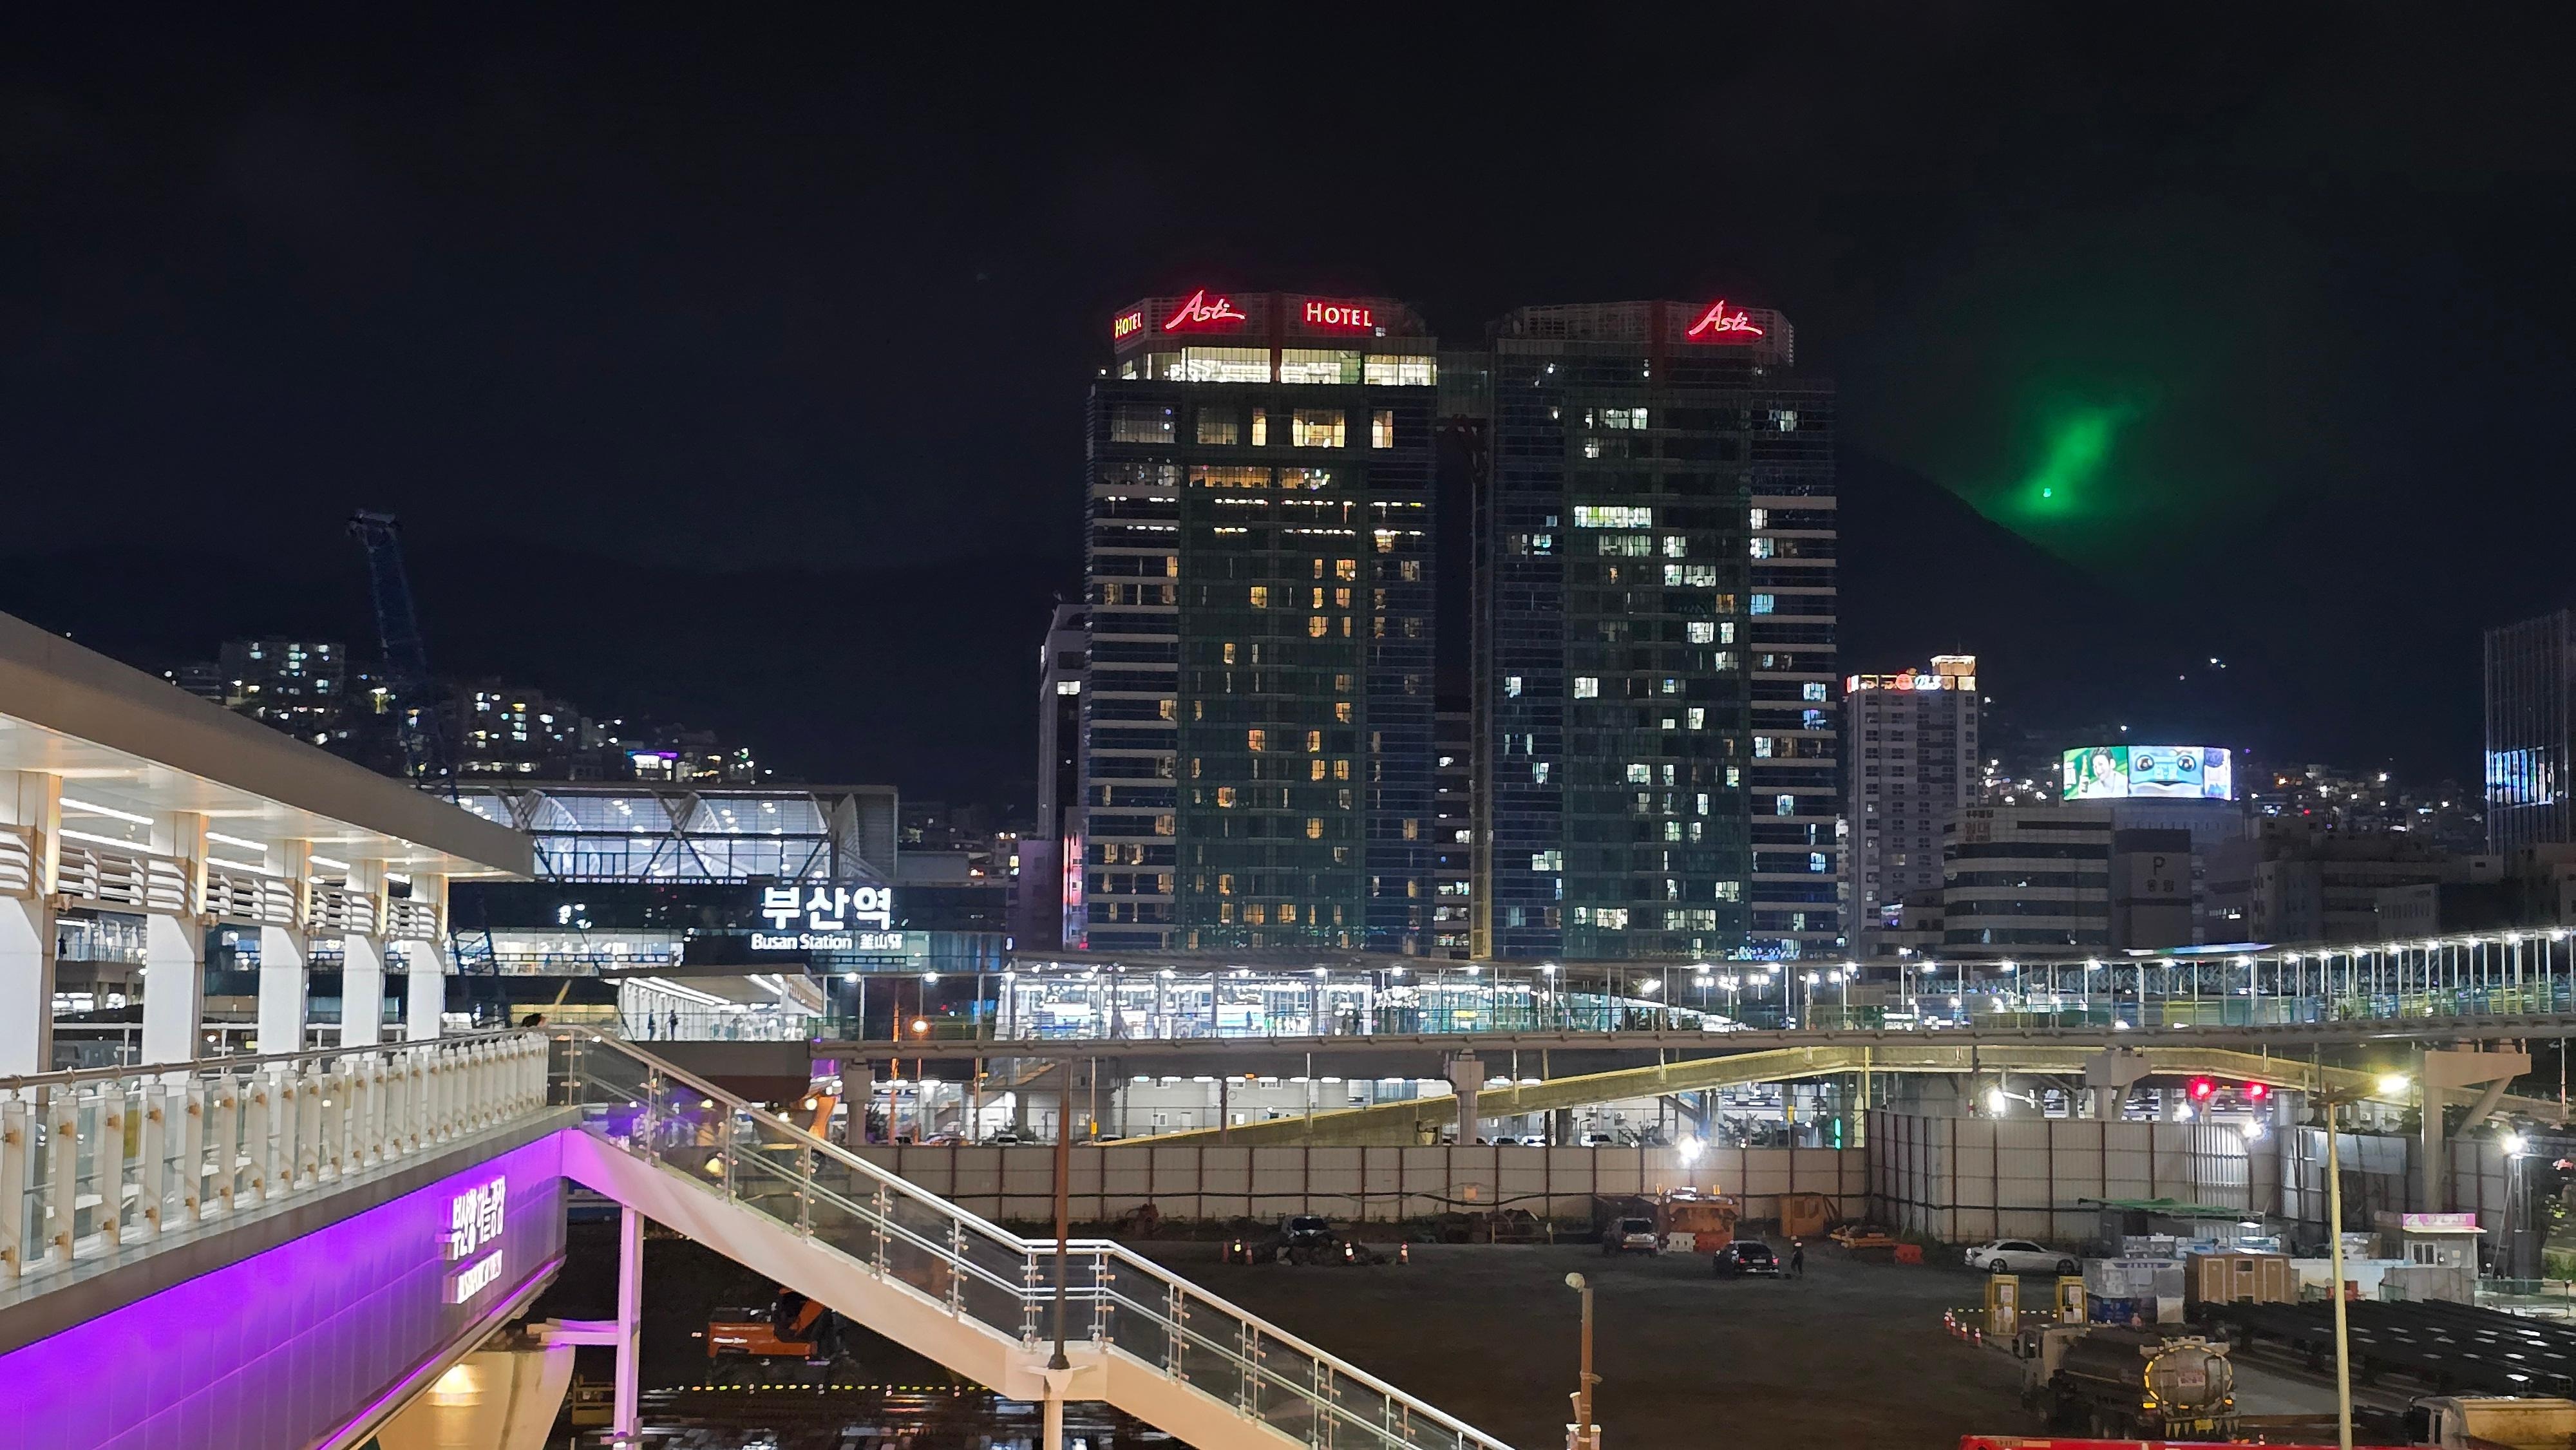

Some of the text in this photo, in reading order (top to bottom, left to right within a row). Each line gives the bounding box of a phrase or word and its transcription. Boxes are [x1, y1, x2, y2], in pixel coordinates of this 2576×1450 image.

[1165, 290, 1246, 330] Asti
[1307, 303, 1372, 327] HOTEL
[1688, 300, 1763, 335] Asti
[1115, 312, 1142, 339] HOTEL
[2153, 856, 2166, 876] P
[762, 887, 892, 930] 부산역
[751, 933, 798, 950] Busan
[799, 933, 853, 950] Station
